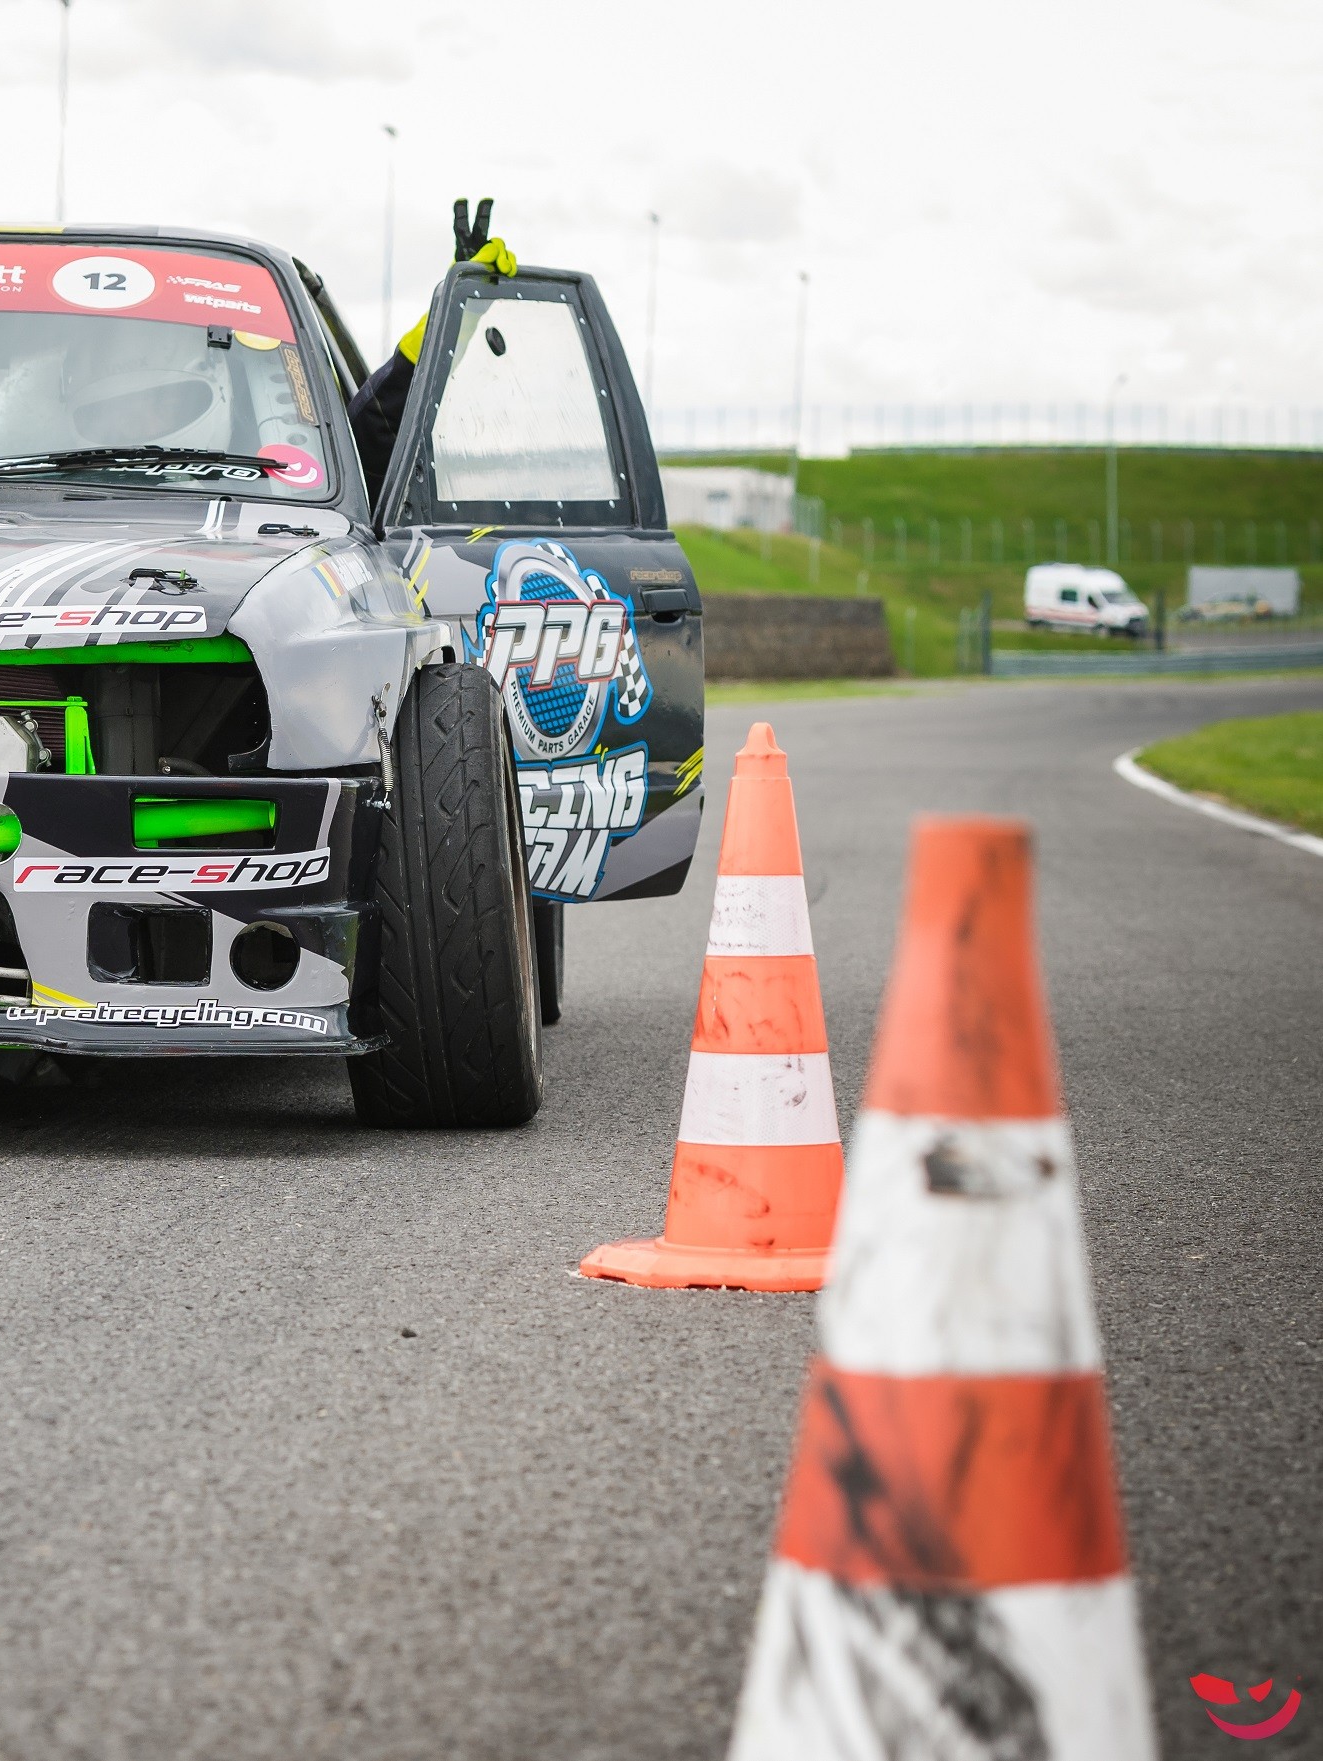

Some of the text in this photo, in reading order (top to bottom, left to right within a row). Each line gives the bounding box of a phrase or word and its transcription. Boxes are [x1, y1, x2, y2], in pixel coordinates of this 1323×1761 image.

[83, 272, 127, 291] 12
[486, 604, 625, 689] PPG
[510, 680, 595, 754] PREMIUM PARTS GARAGE
[518, 750, 646, 829] CING
[15, 856, 329, 885] race-shop
[7, 1001, 327, 1033] topcatrecycling.com
